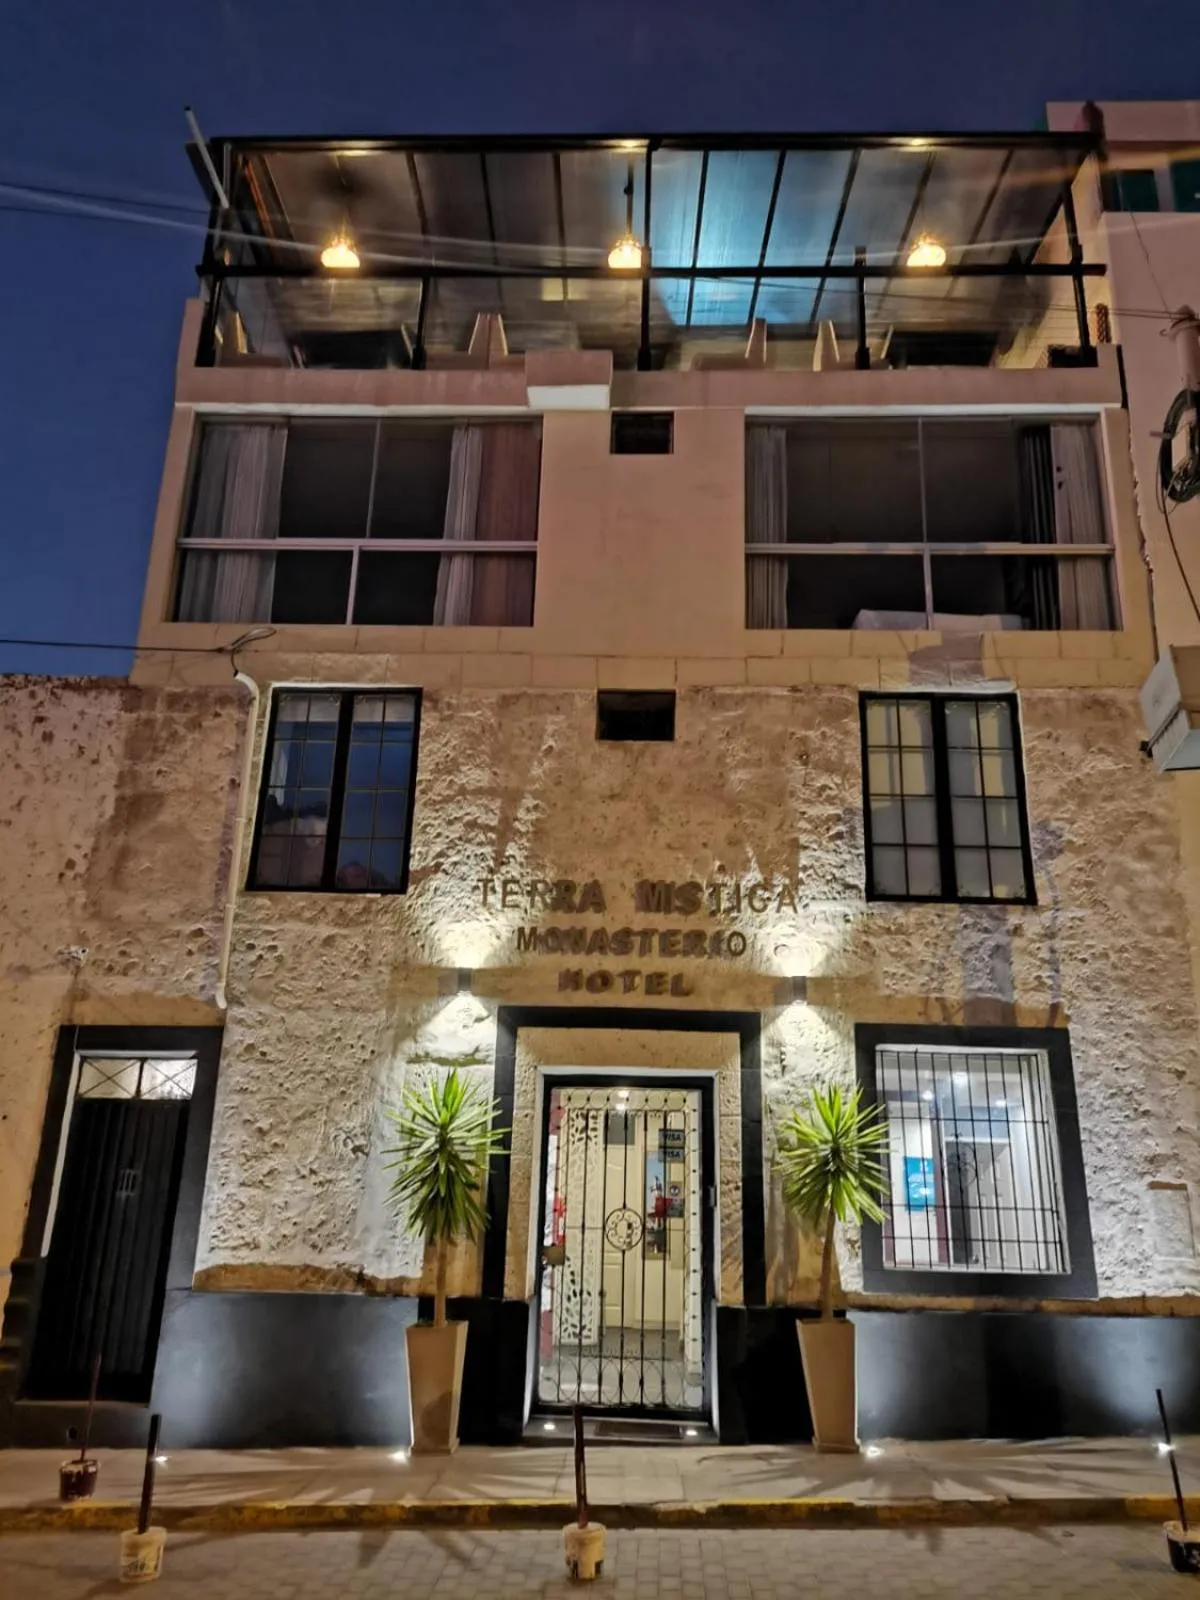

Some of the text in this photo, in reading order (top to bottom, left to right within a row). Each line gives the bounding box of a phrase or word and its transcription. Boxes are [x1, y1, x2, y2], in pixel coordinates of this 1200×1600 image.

[477, 878, 798, 916] TERRA MISTICA
[517, 926, 747, 958] MONASTERIO
[558, 968, 694, 997] HOTEL
